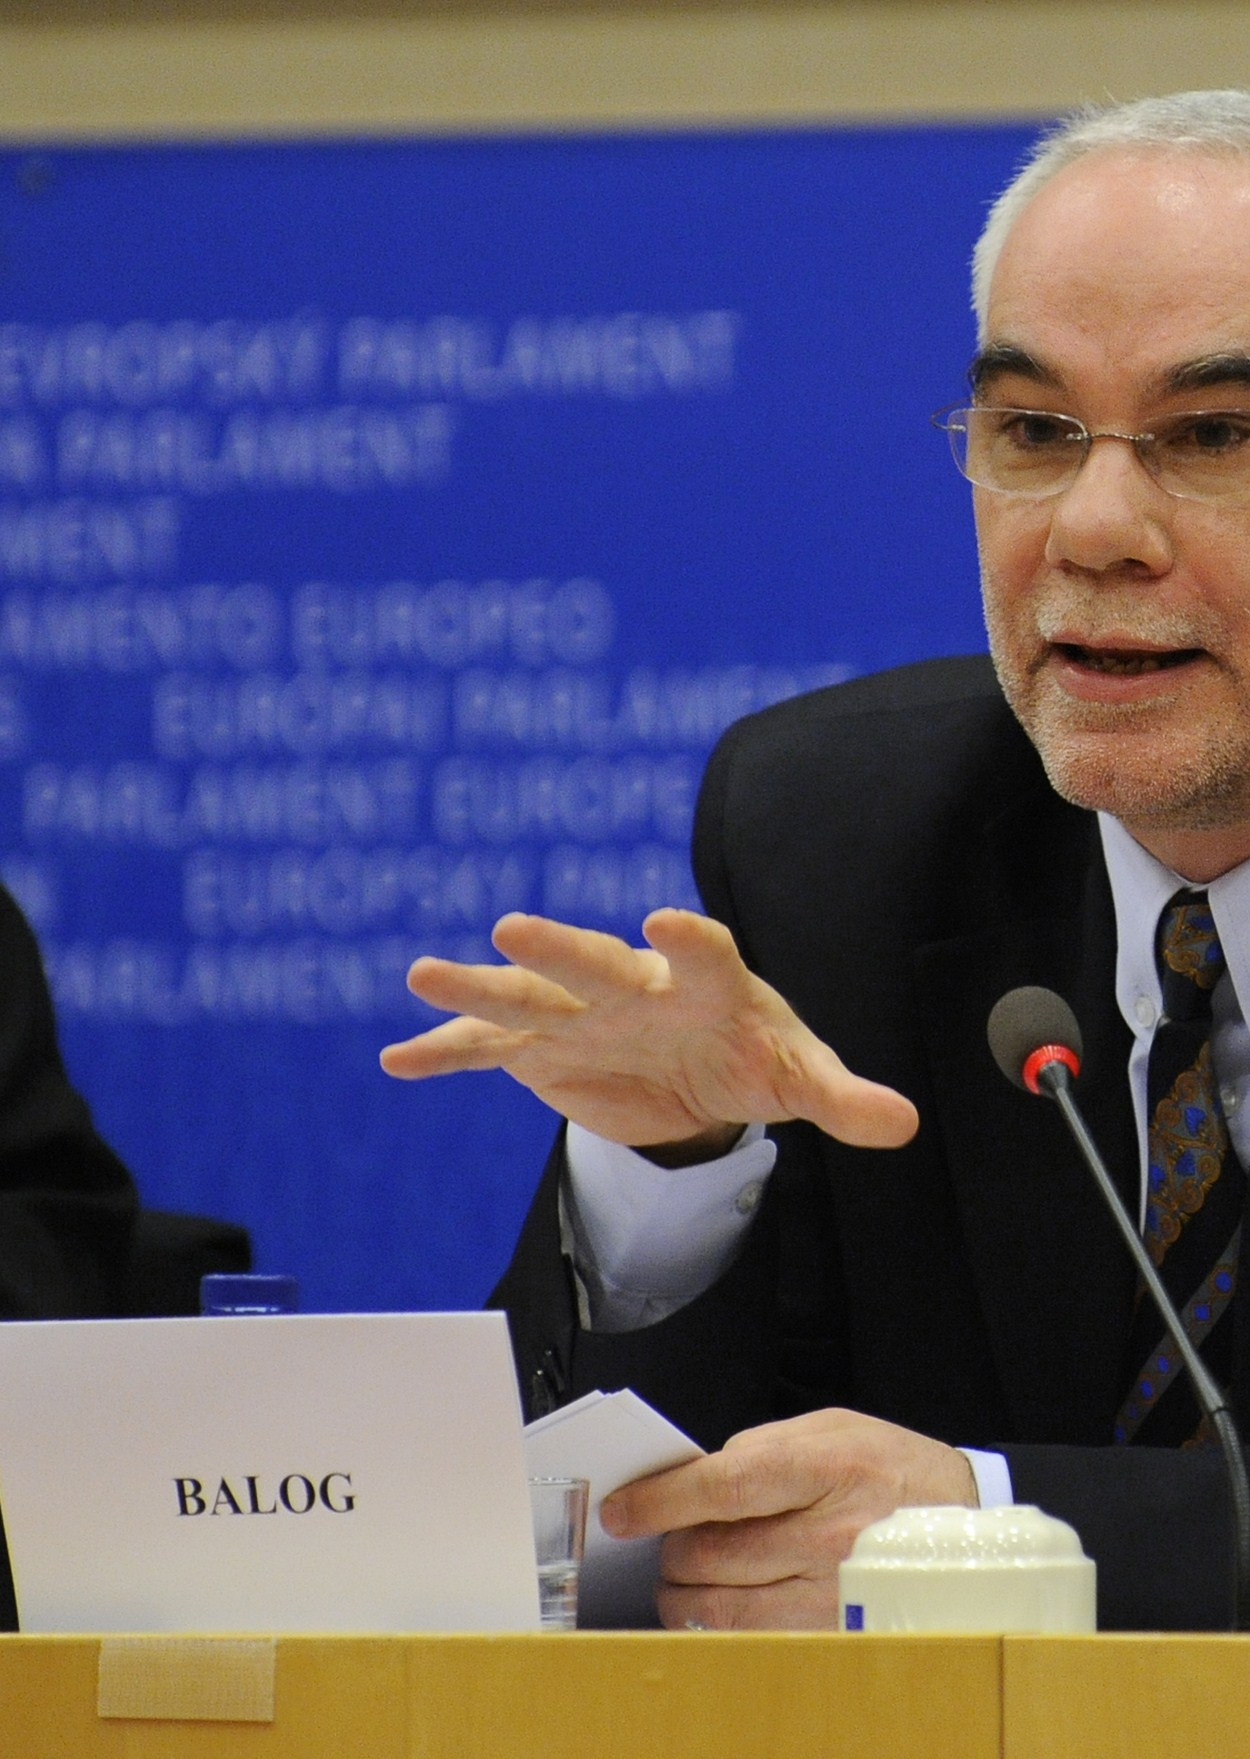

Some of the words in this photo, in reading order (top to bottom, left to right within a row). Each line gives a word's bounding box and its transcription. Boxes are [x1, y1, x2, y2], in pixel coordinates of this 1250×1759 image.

[338, 312, 738, 398] PARLAMENT
[58, 404, 452, 492] PARLAMENT
[292, 580, 612, 666] EUROPEO
[22, 760, 418, 846] PARLAMENT
[173, 1472, 358, 1517] BALOG
